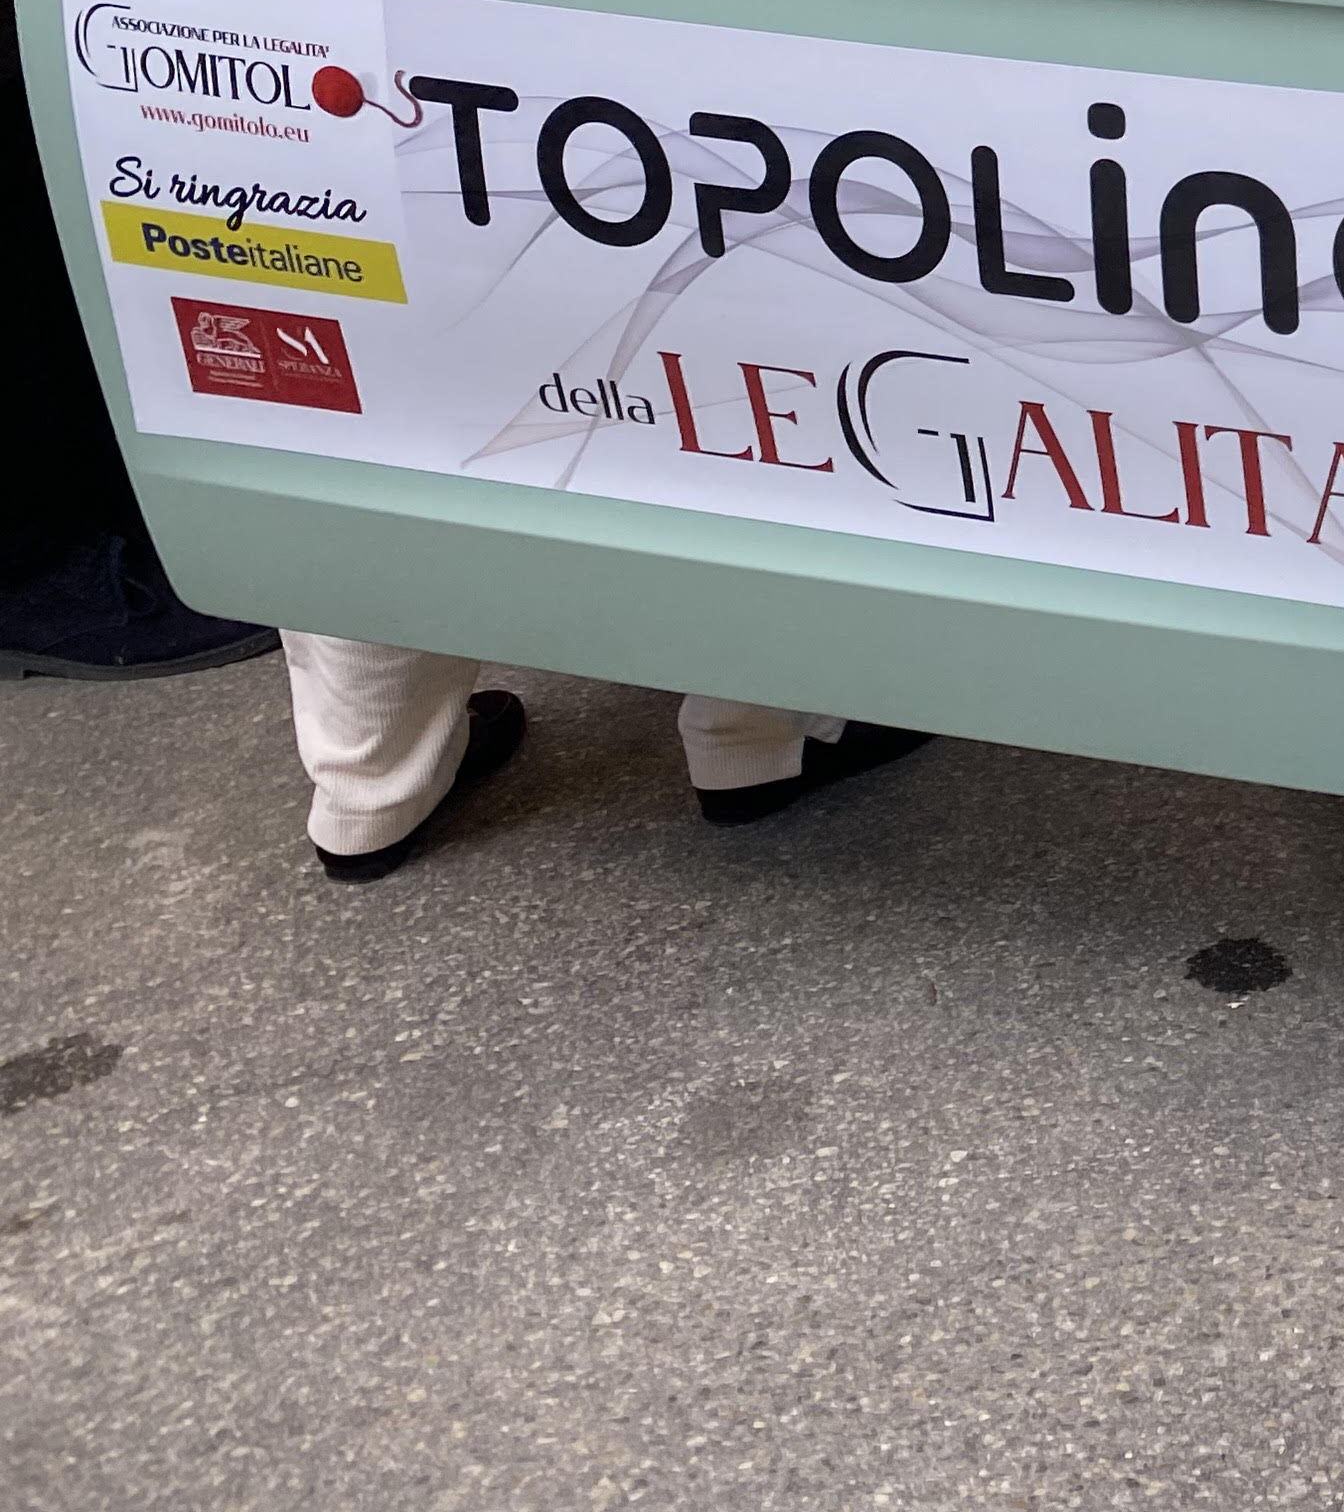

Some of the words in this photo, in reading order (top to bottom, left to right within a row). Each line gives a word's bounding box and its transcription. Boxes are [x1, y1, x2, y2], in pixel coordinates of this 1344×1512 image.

[111, 15, 210, 42] ASSOCIAZIONE
[212, 30, 241, 47] PER
[243, 34, 261, 49] LA
[139, 104, 311, 144] www.gomitolo.eu
[109, 155, 161, 199] Si
[168, 173, 368, 232] ringrazia
[141, 221, 364, 283] Posteitaliane
[195, 352, 266, 374] GENERALI
[538, 372, 656, 427] della
